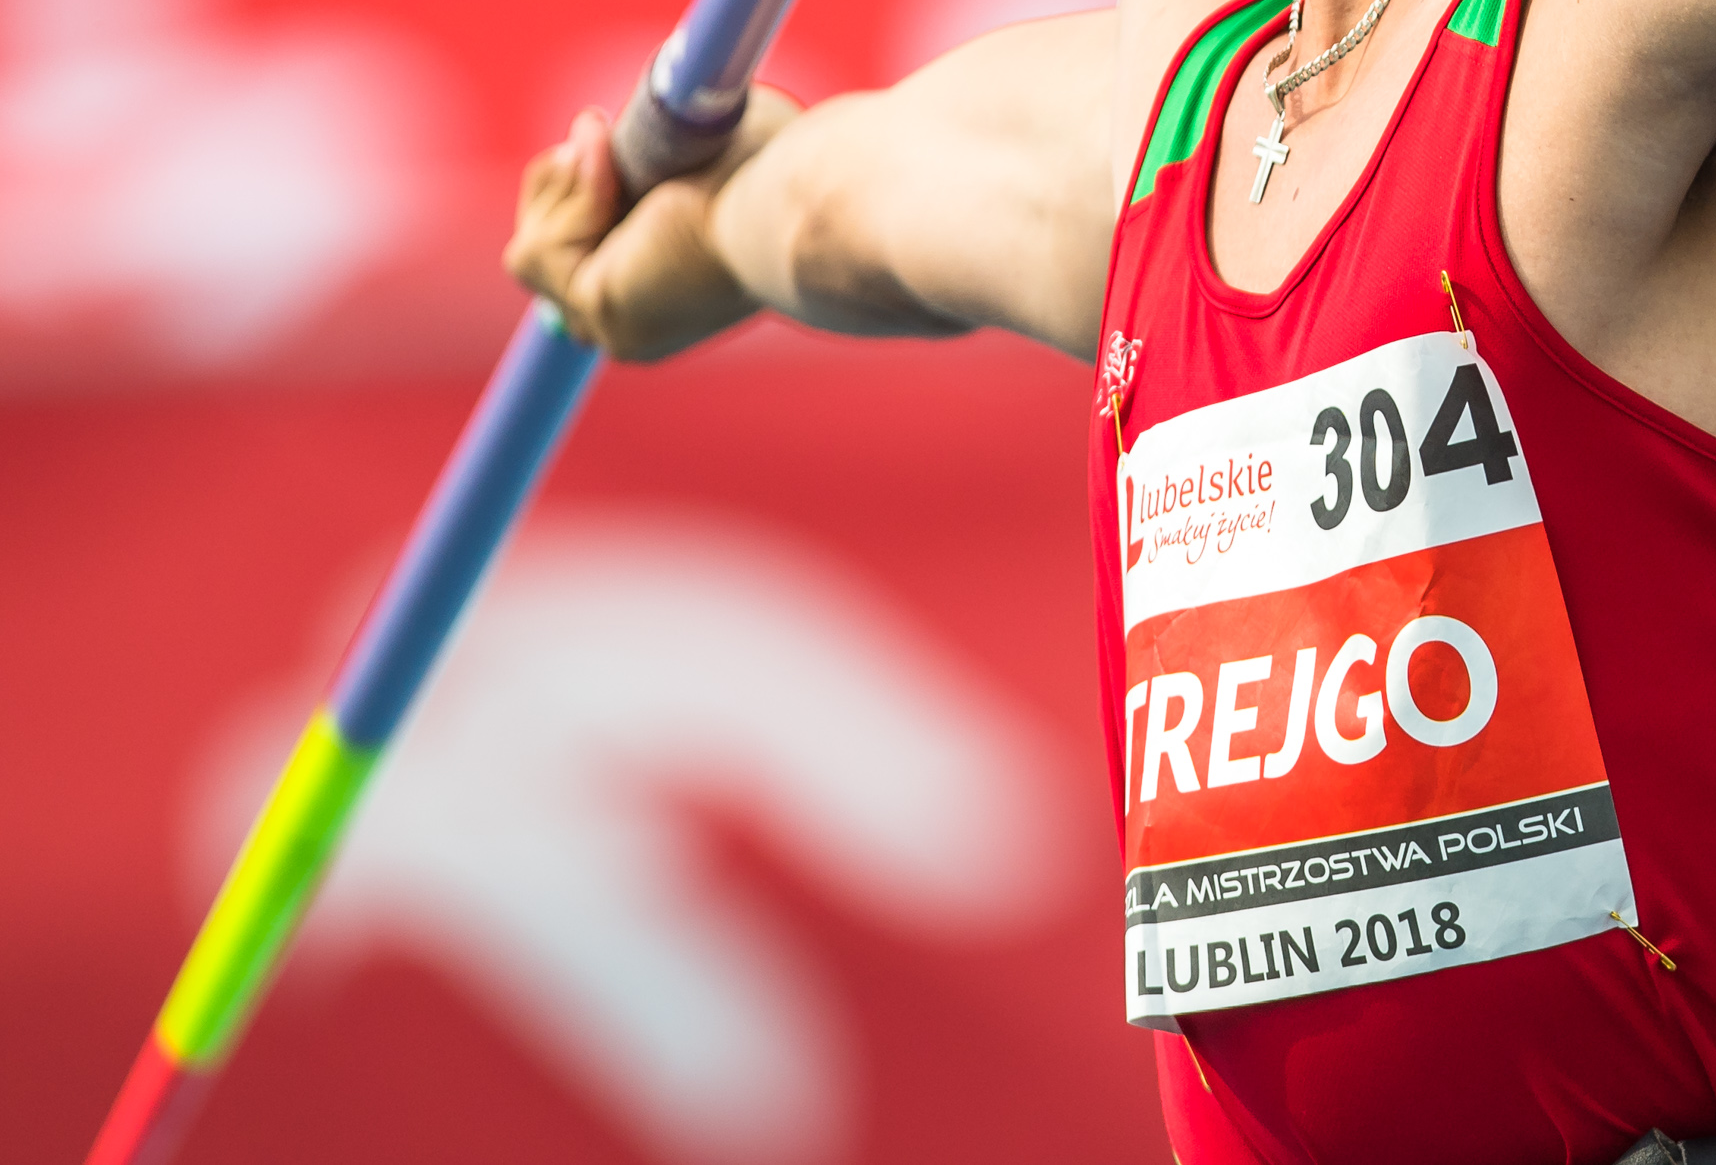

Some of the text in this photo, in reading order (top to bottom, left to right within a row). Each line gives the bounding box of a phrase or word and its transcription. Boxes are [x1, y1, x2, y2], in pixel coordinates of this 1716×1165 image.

[1308, 362, 1519, 531] 304
[1217, 499, 1277, 554] życie!
[1186, 840, 1432, 906] MISTRZOSTWA
[1438, 806, 1585, 862] POLSKI
[1137, 900, 1467, 997] LUBLIN 2018
